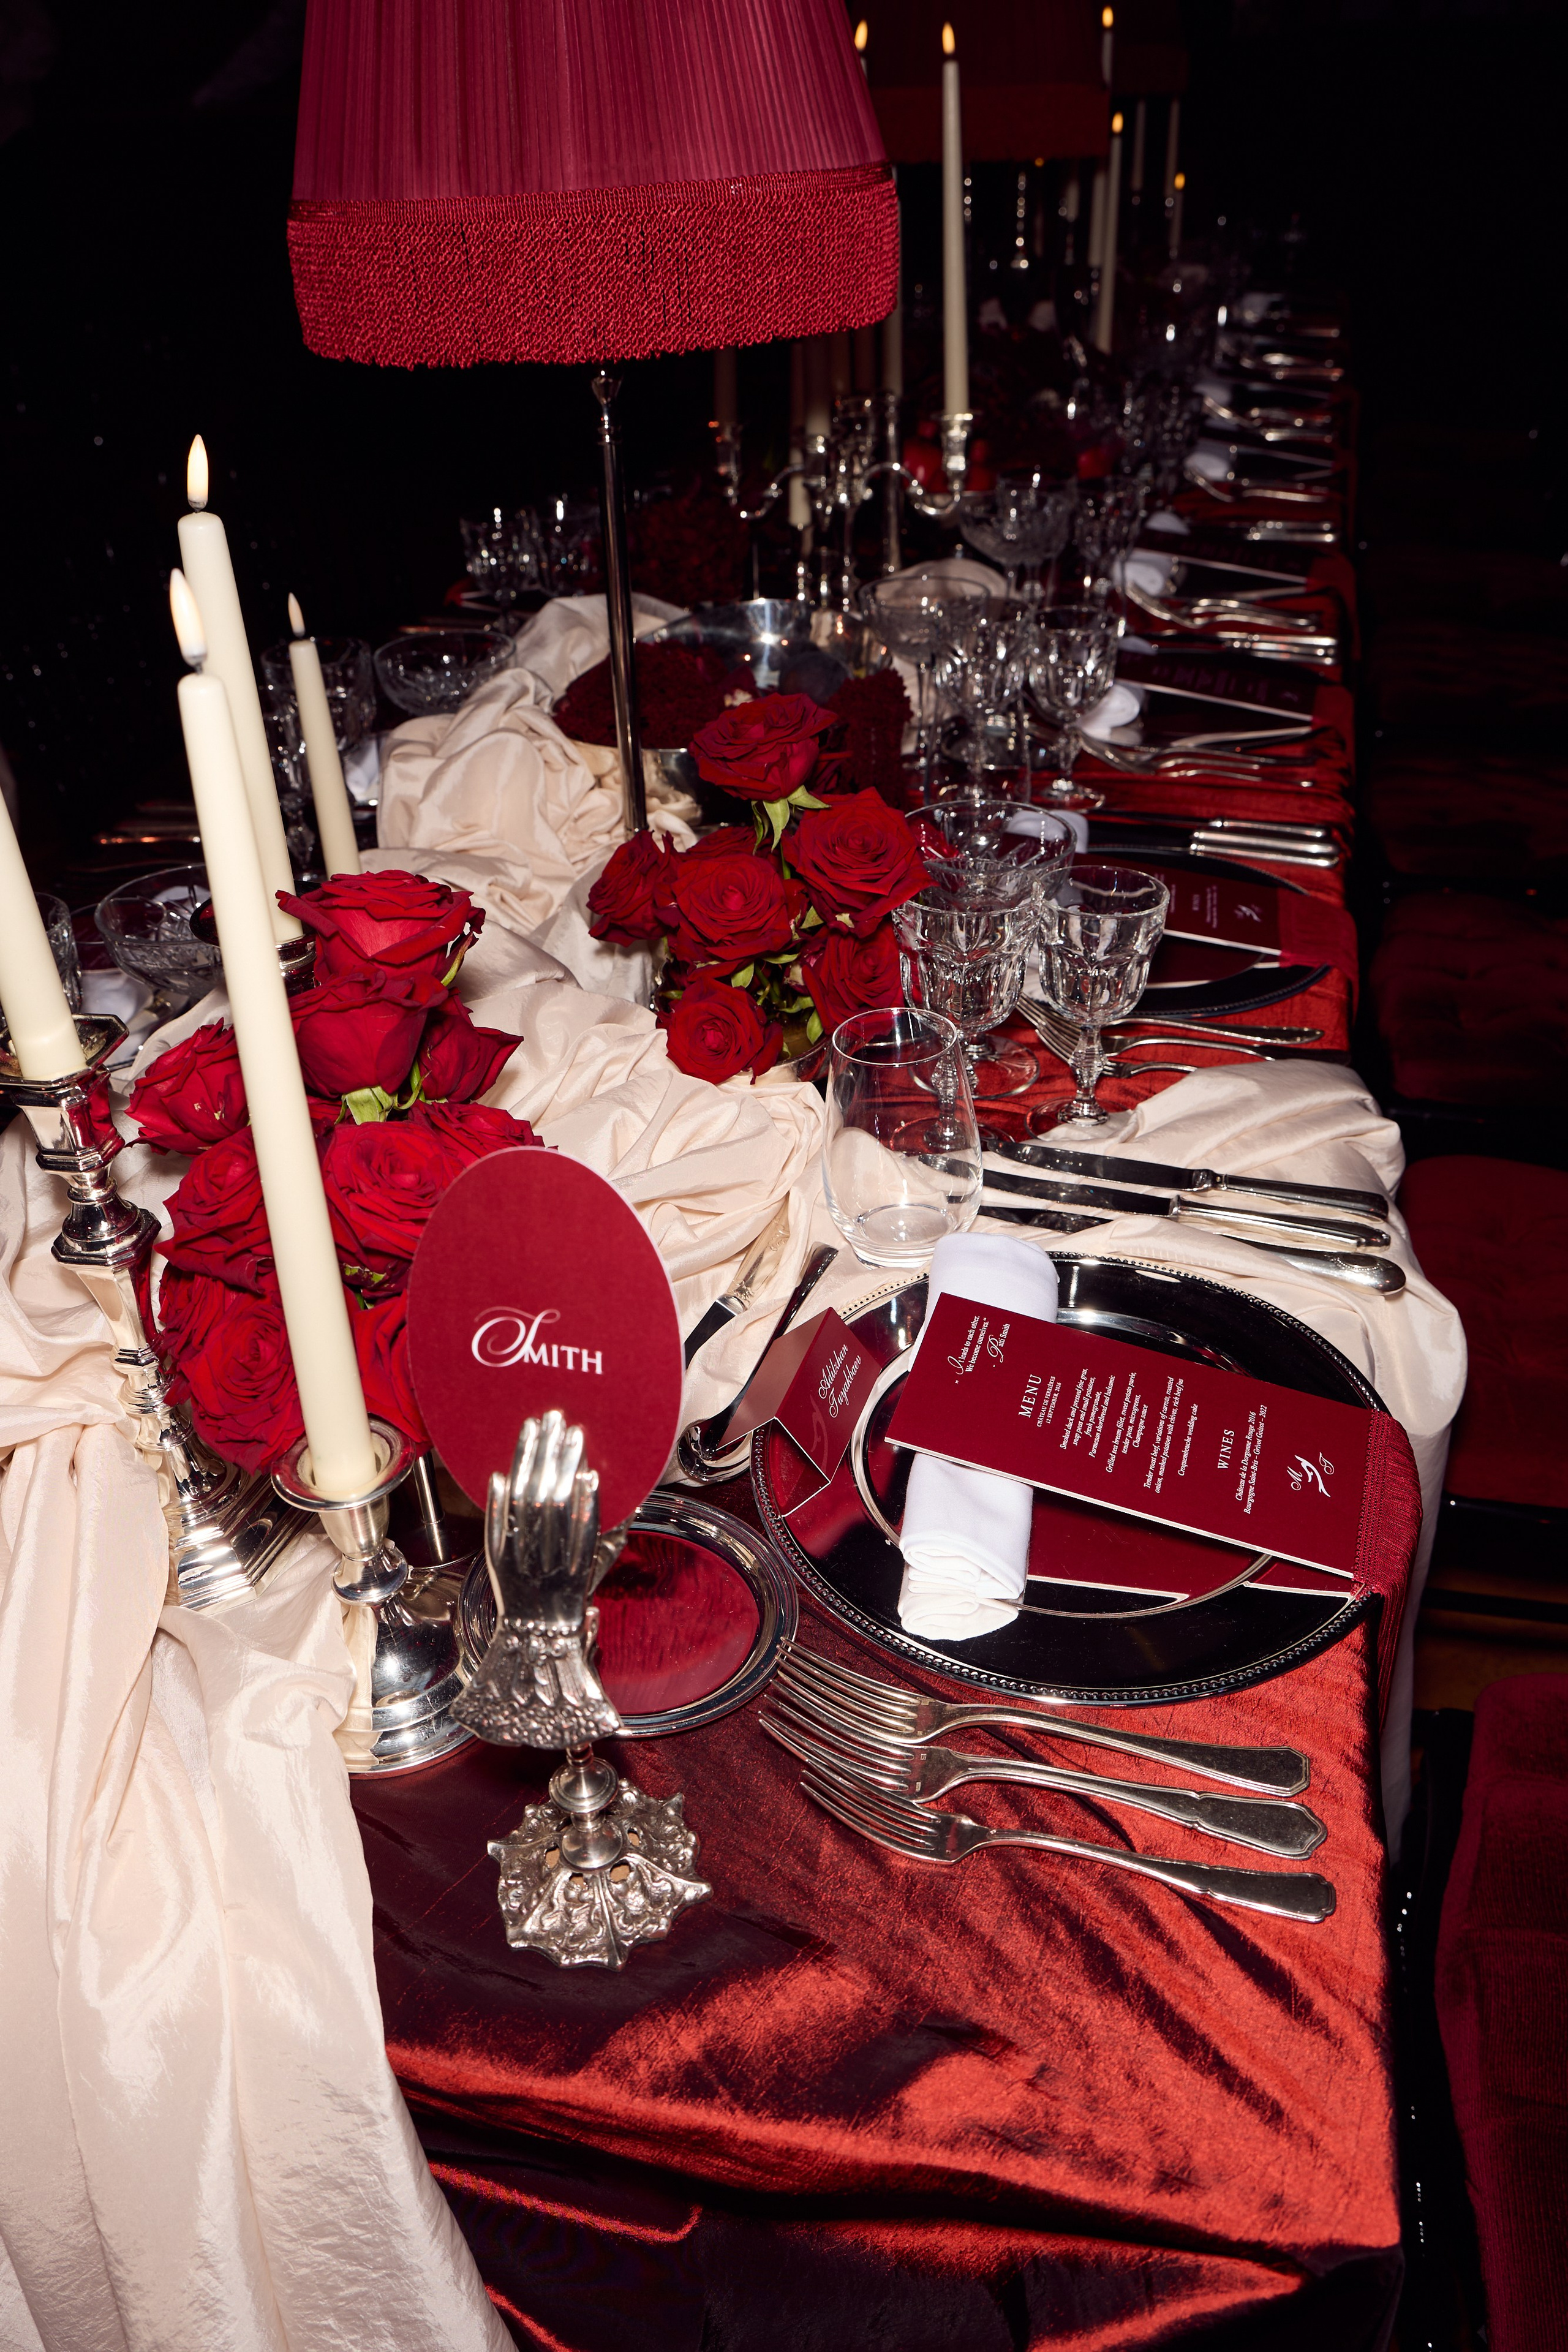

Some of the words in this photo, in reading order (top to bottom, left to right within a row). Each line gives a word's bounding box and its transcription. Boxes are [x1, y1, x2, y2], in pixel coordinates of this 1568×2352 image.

[1000, 1324, 1010, 1338] Smith
[968, 1344, 981, 1364] become
[818, 1344, 848, 1399] Adilzhan
[829, 1355, 861, 1418] Tuyakbaev
[1018, 1374, 1042, 1418] MENU
[1060, 1428, 1071, 1450] Smoked
[1073, 1388, 1082, 1409] pressed
[1084, 1423, 1093, 1438] fresh
[1088, 1432, 1101, 1458] Parmesan
[1095, 1404, 1107, 1433] shortbread
[1104, 1375, 1115, 1396] balsamic
[1256, 1422, 1265, 1438] Goisot
[1121, 1437, 1130, 1454] tender
[1133, 1419, 1145, 1447] Champagne
[1178, 1436, 1191, 1476] Croquembouche
[1187, 1415, 1197, 1436] wedding
[1245, 1424, 1256, 1441] Rouge
[1253, 1438, 1262, 1455] Grivot
[1106, 1453, 1116, 1472] Grilled
[1112, 1428, 1122, 1445] bream
[1144, 1470, 1153, 1488] Tender
[1155, 1419, 1165, 1444] variations
[1158, 1455, 1167, 1477] mashed
[1163, 1435, 1172, 1458] potatoes
[1217, 1429, 1234, 1469] WINES
[1241, 1441, 1251, 1466] Dorgonne
[1248, 1460, 1259, 1485] Saint-Bris
[1243, 1485, 1255, 1514] Bourgogne
